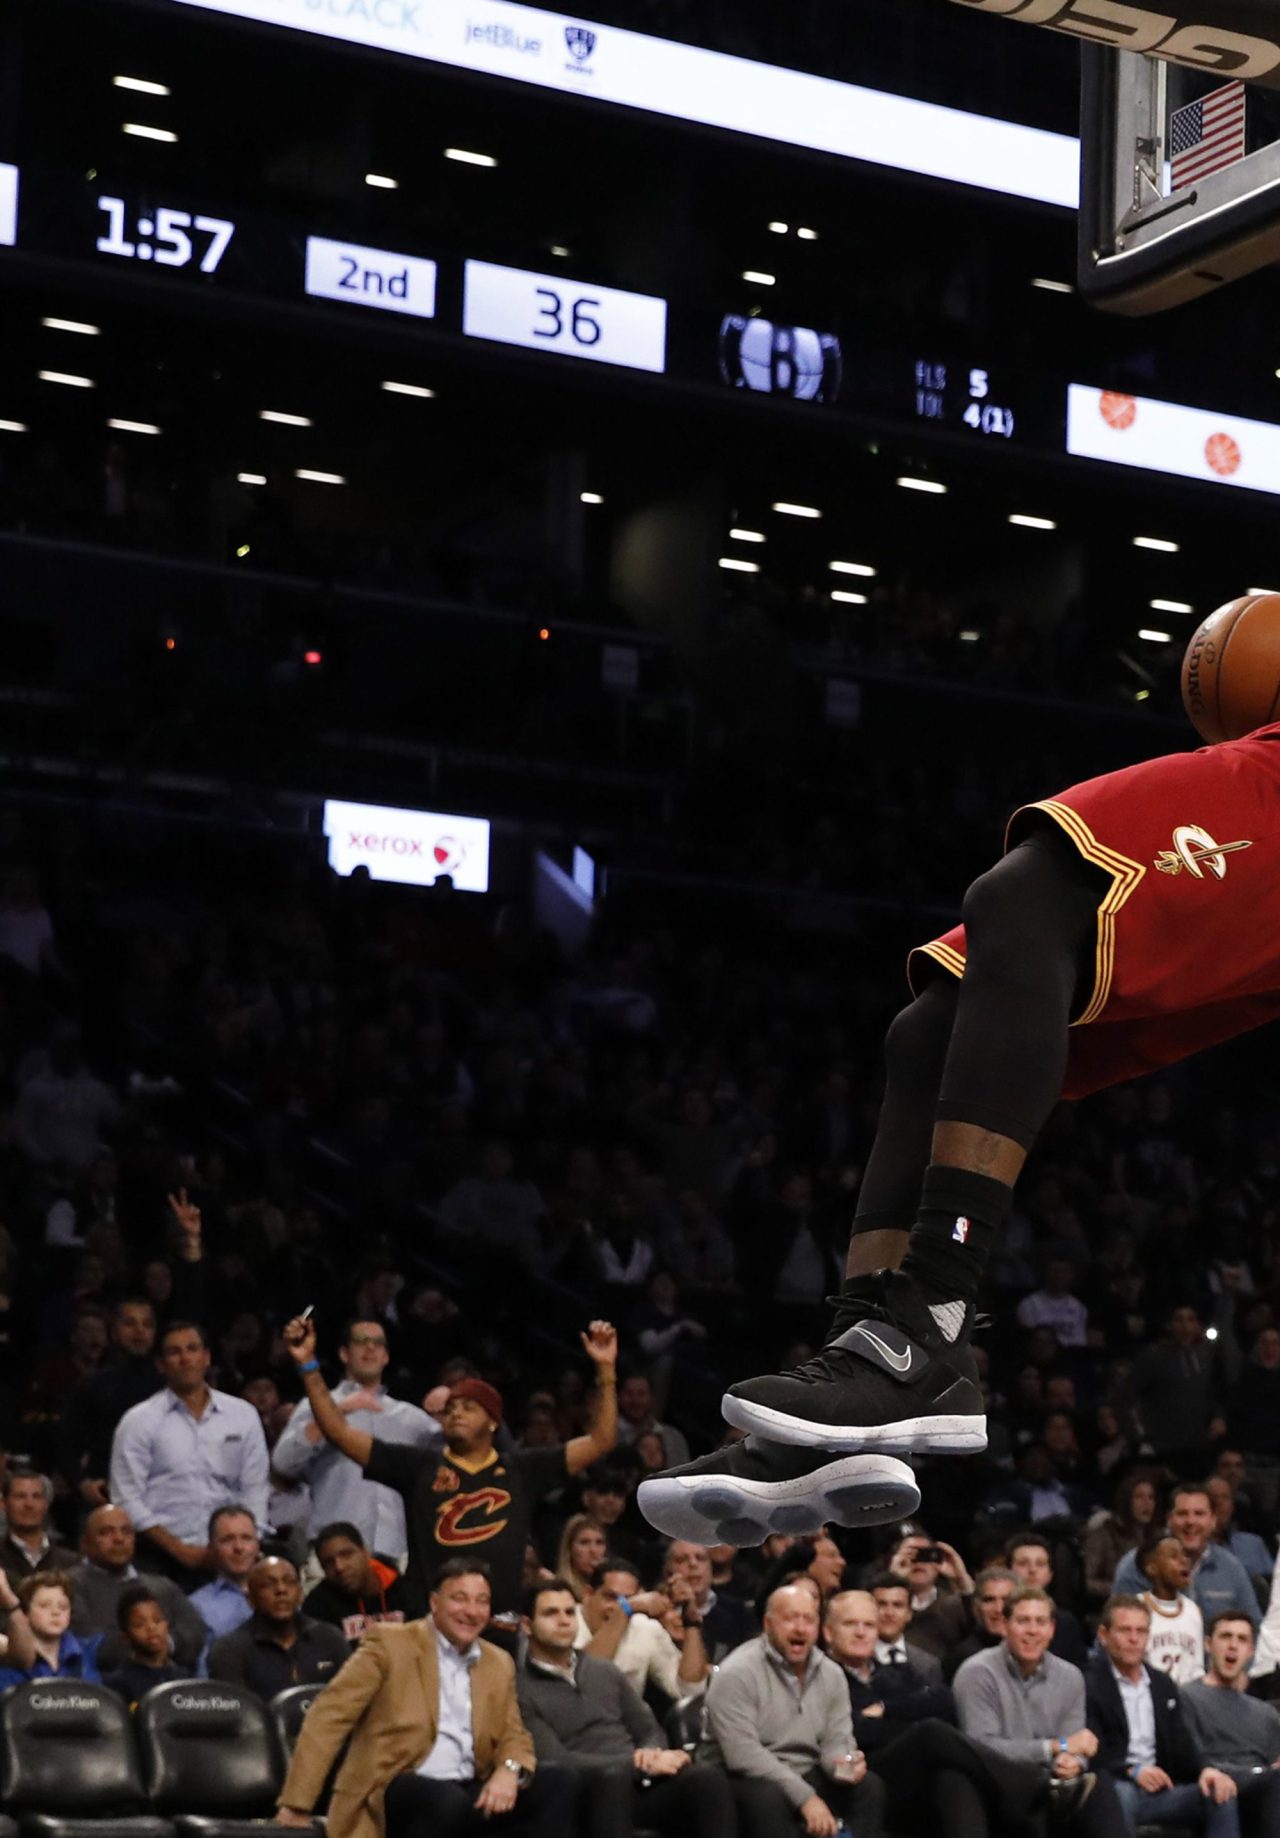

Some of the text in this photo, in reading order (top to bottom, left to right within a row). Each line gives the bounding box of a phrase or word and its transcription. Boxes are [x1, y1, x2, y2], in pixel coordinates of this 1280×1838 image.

[96, 195, 235, 274] 1:57
[338, 255, 410, 299] 2nd
[532, 288, 601, 346] 36
[968, 367, 989, 399] 5
[963, 403, 1014, 438] 4(1)
[349, 831, 423, 857] xerox
